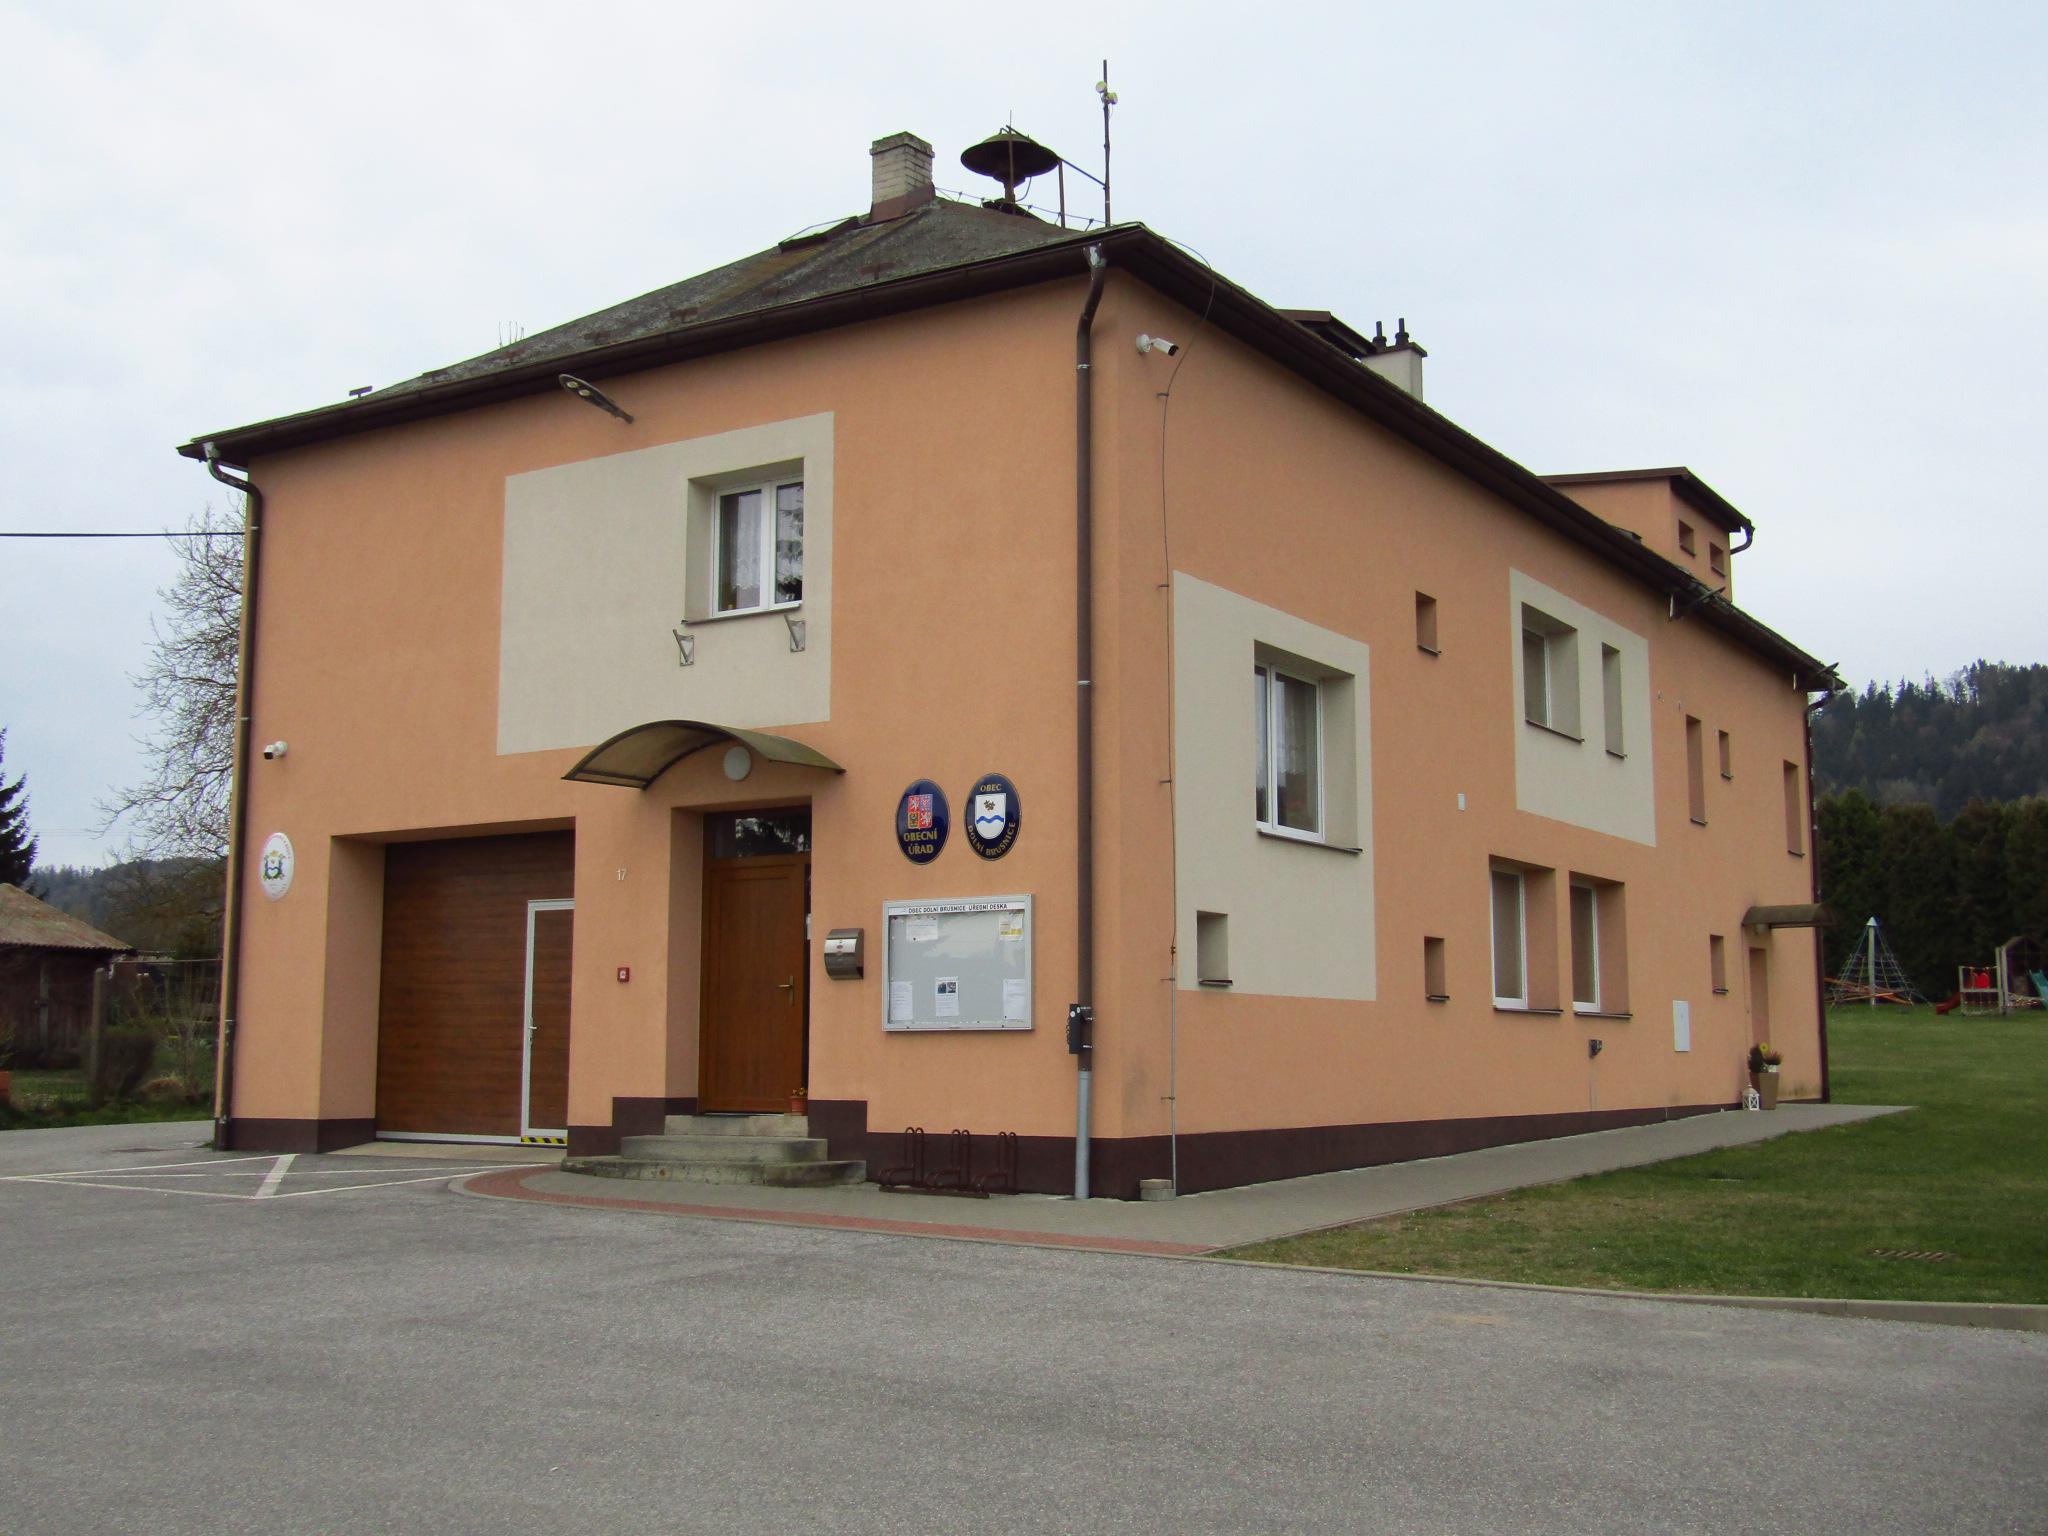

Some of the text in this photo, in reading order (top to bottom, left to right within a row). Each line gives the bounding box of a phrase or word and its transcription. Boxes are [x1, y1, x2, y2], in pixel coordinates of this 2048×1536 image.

[980, 783, 1002, 792] OBEC
[903, 828, 938, 841] OBECNÍ
[967, 822, 1016, 856] DOLNÍ BRUSNICE
[908, 843, 934, 855] ÚŘAD
[616, 868, 627, 880] 17
